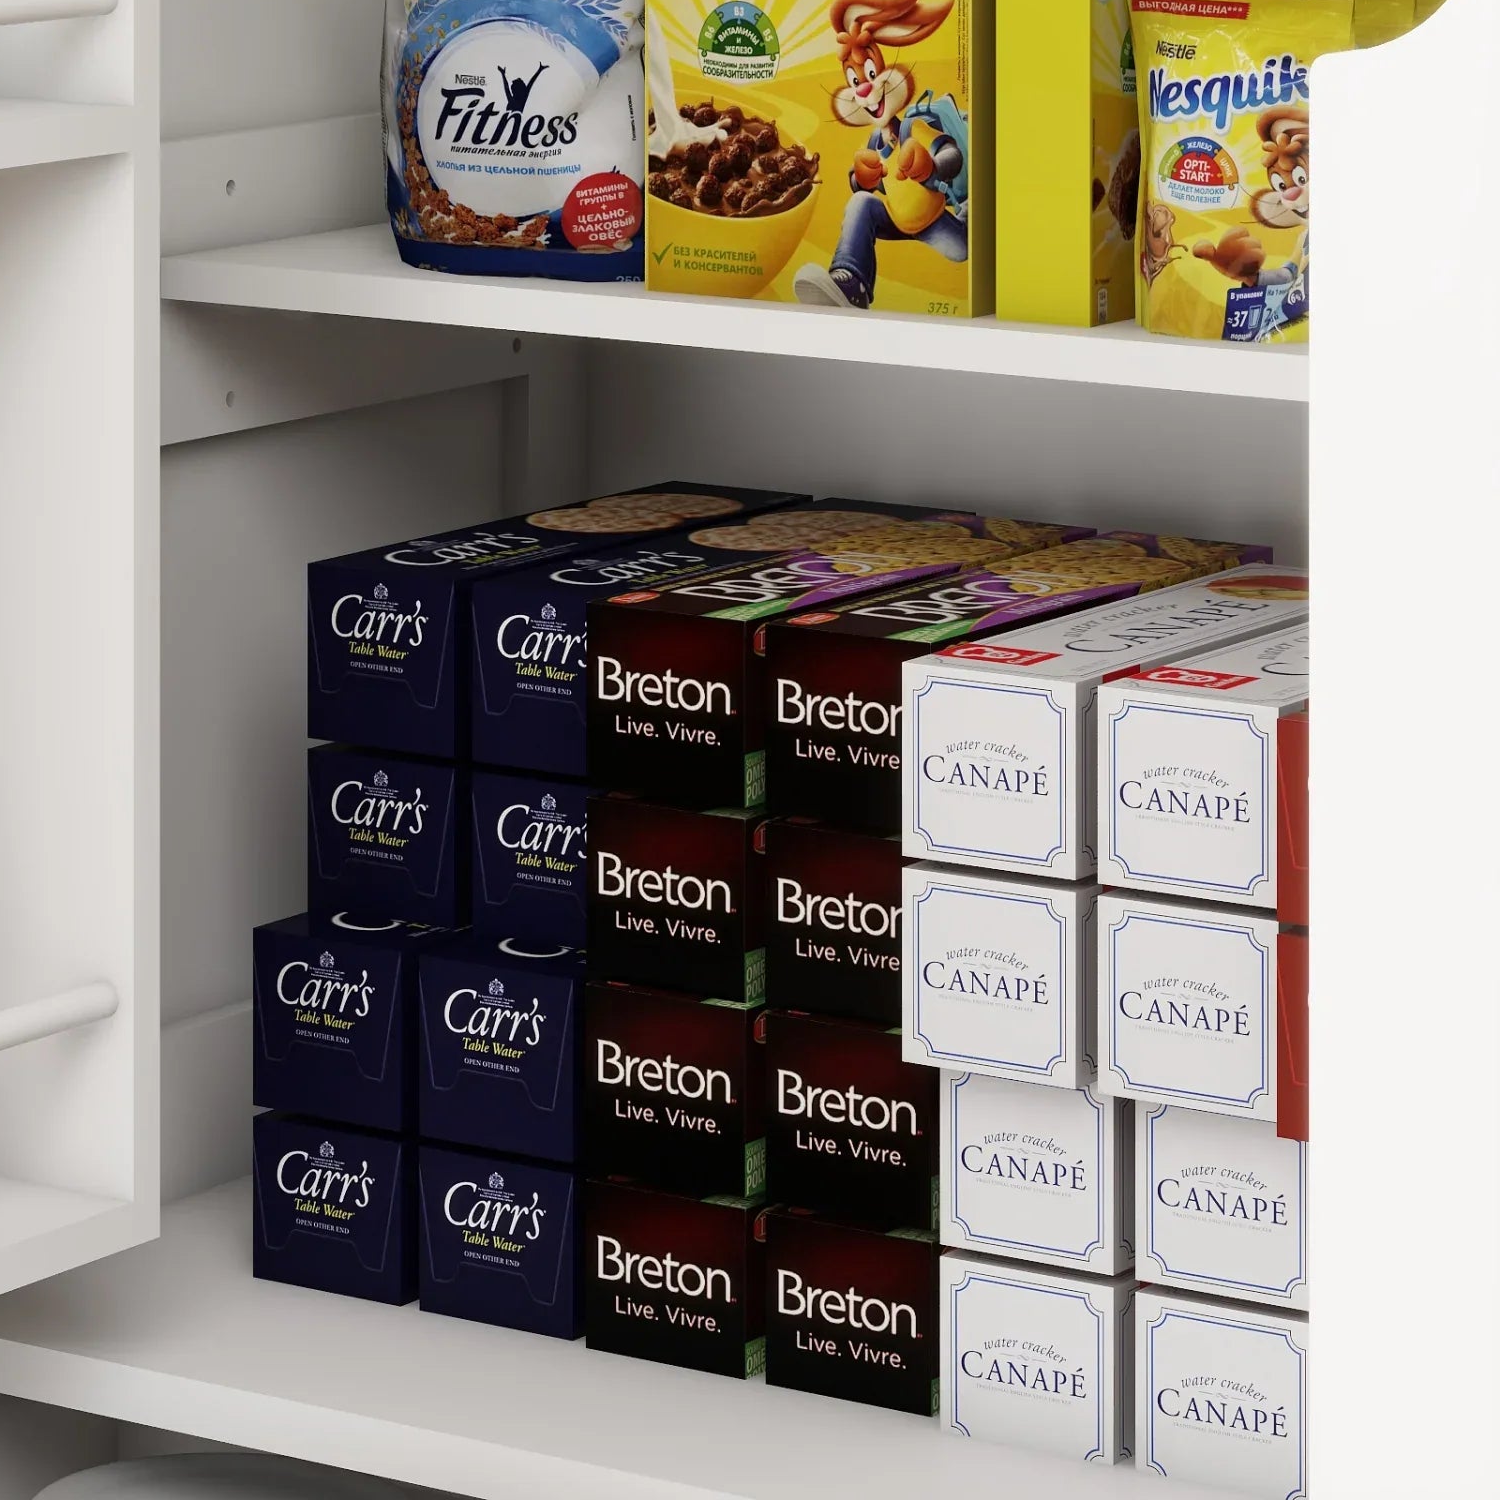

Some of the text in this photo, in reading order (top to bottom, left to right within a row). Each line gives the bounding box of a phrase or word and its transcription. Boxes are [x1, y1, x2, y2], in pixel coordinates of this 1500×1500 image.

[1138, 0, 1196, 13] ВЫГОДНАЯ
[717, 26, 760, 46] ВИТАМИНЫ
[724, 45, 754, 55] ЖЕЛЕЗО
[1155, 39, 1197, 61] Nestlé
[454, 74, 487, 86] Nestlé
[703, 65, 774, 79] СООБРАЗИТЕЛЬНОСТИ
[1148, 55, 1310, 130] Nesquik
[435, 87, 579, 149] Fitness
[451, 144, 562, 160] питательная энергия
[1187, 141, 1213, 152] ЖЕЛЕЗО
[436, 160, 582, 176] ХЛОПЬЯ ИЗ ЦЕЛЬНОЙ ПШЕНИЦЫ
[1179, 169, 1211, 182] START
[1184, 159, 1211, 172] OPTI-
[576, 182, 629, 198] ВИТАМИНЫ
[579, 194, 617, 207] ГРУППЫ
[1168, 182, 1225, 195] ДЕЛАЕТ МОЛОКО
[1185, 194, 1221, 204] ПОЛЕЗНЕЕ
[572, 215, 636, 233] ЗЛАКОВЫЙ
[578, 208, 629, 224] ЦЕЛЬНО-
[588, 229, 624, 241] ОВЁС
[673, 246, 757, 263] БЕЗ КРАСИТЕЛЕЙ
[673, 259, 764, 276] И КОНСЕРВАНТОВ
[927, 301, 950, 315] 375
[384, 532, 540, 566] Carr's
[331, 594, 429, 647] Carr's
[1065, 599, 1270, 654] CANAPÉ
[348, 640, 409, 660] Table Water
[350, 660, 404, 674] OPEN OTHER END
[597, 655, 732, 715] Breton
[615, 714, 721, 746] Live. Vivre.
[946, 740, 1029, 764] water cracker
[922, 754, 1049, 797] CANAPÉ
[1143, 765, 1229, 790] water cracker
[331, 780, 429, 835] Carr's
[1119, 779, 1251, 824] CANAPÉ
[597, 850, 732, 914] Breton
[795, 938, 901, 971] Live. Vivre
[276, 961, 375, 1018] Carr's
[922, 960, 1049, 1005] CANAPÉ
[443, 988, 546, 1046] Carr's
[1119, 990, 1251, 1037] CANAPÉ
[462, 1036, 526, 1060] Table Water
[597, 1038, 732, 1104] Breton
[777, 1068, 917, 1136] Breton
[276, 1150, 375, 1208] Carr's
[960, 1144, 1087, 1192] CANAPÉ
[294, 1197, 355, 1221] Table Water
[443, 1181, 546, 1241] Carr's
[1157, 1177, 1289, 1227] CANAPÉ
[597, 1234, 732, 1304] Breton
[777, 1268, 917, 1338] Breton
[982, 1336, 1067, 1364] water cracker
[960, 1350, 1087, 1399] CANAPÉ
[1157, 1388, 1289, 1438] CANAPÉ
